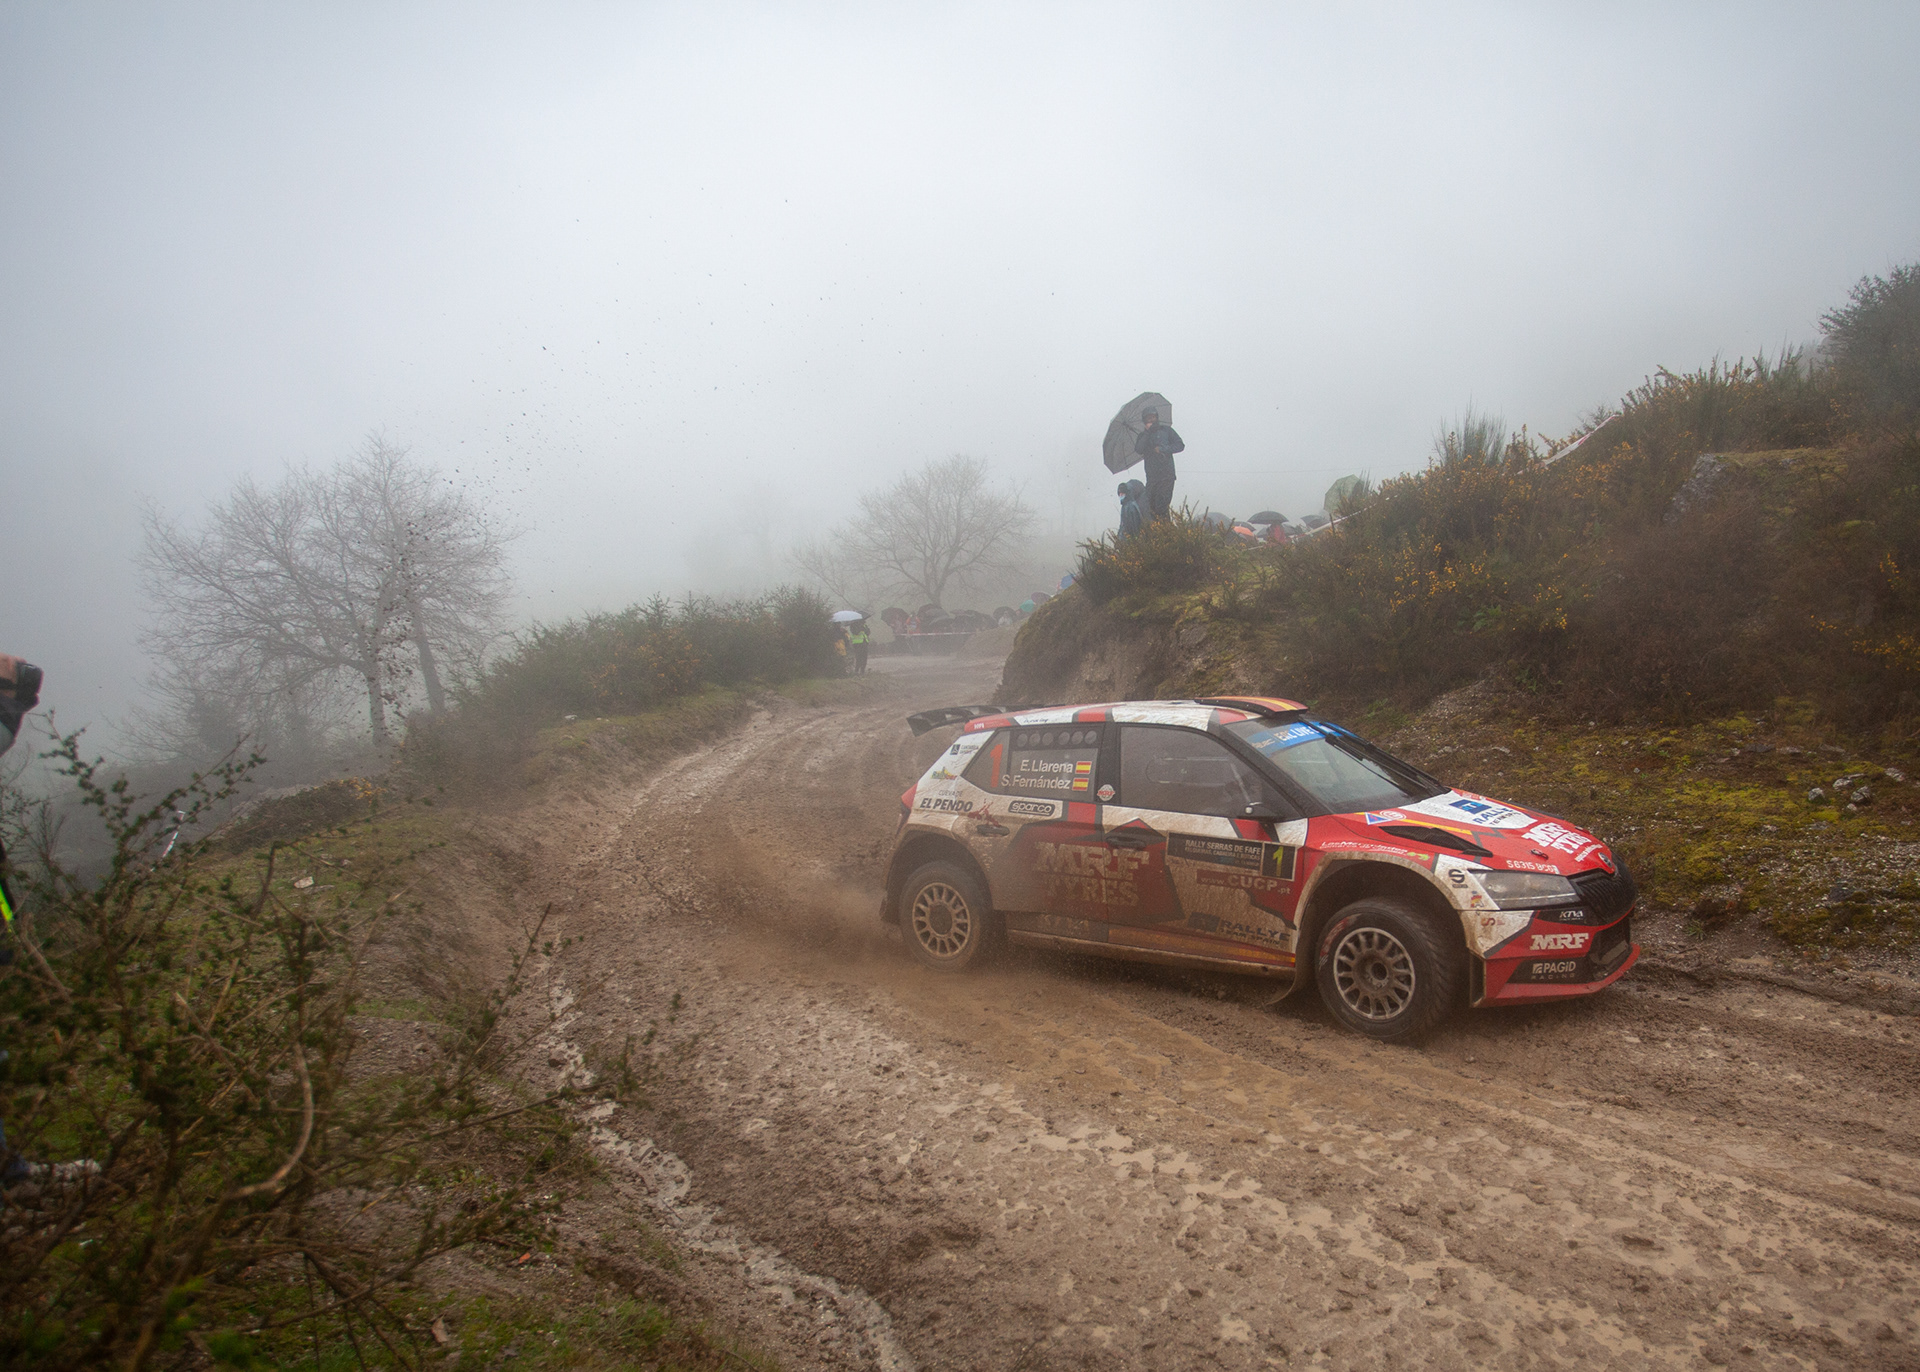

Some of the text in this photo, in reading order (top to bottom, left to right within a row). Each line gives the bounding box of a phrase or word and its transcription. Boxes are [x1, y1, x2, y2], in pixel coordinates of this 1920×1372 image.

[990, 744, 1003, 788] 1
[920, 798, 973, 813] EL PENDO
[1011, 801, 1052, 814] sparco
[1185, 840, 1261, 855] RALLY SERRAS DE FAFE
[1035, 842, 1149, 880] MRF
[1272, 846, 1284, 876] 1
[1506, 860, 1514, 869] S
[1530, 932, 1589, 950] MRF
